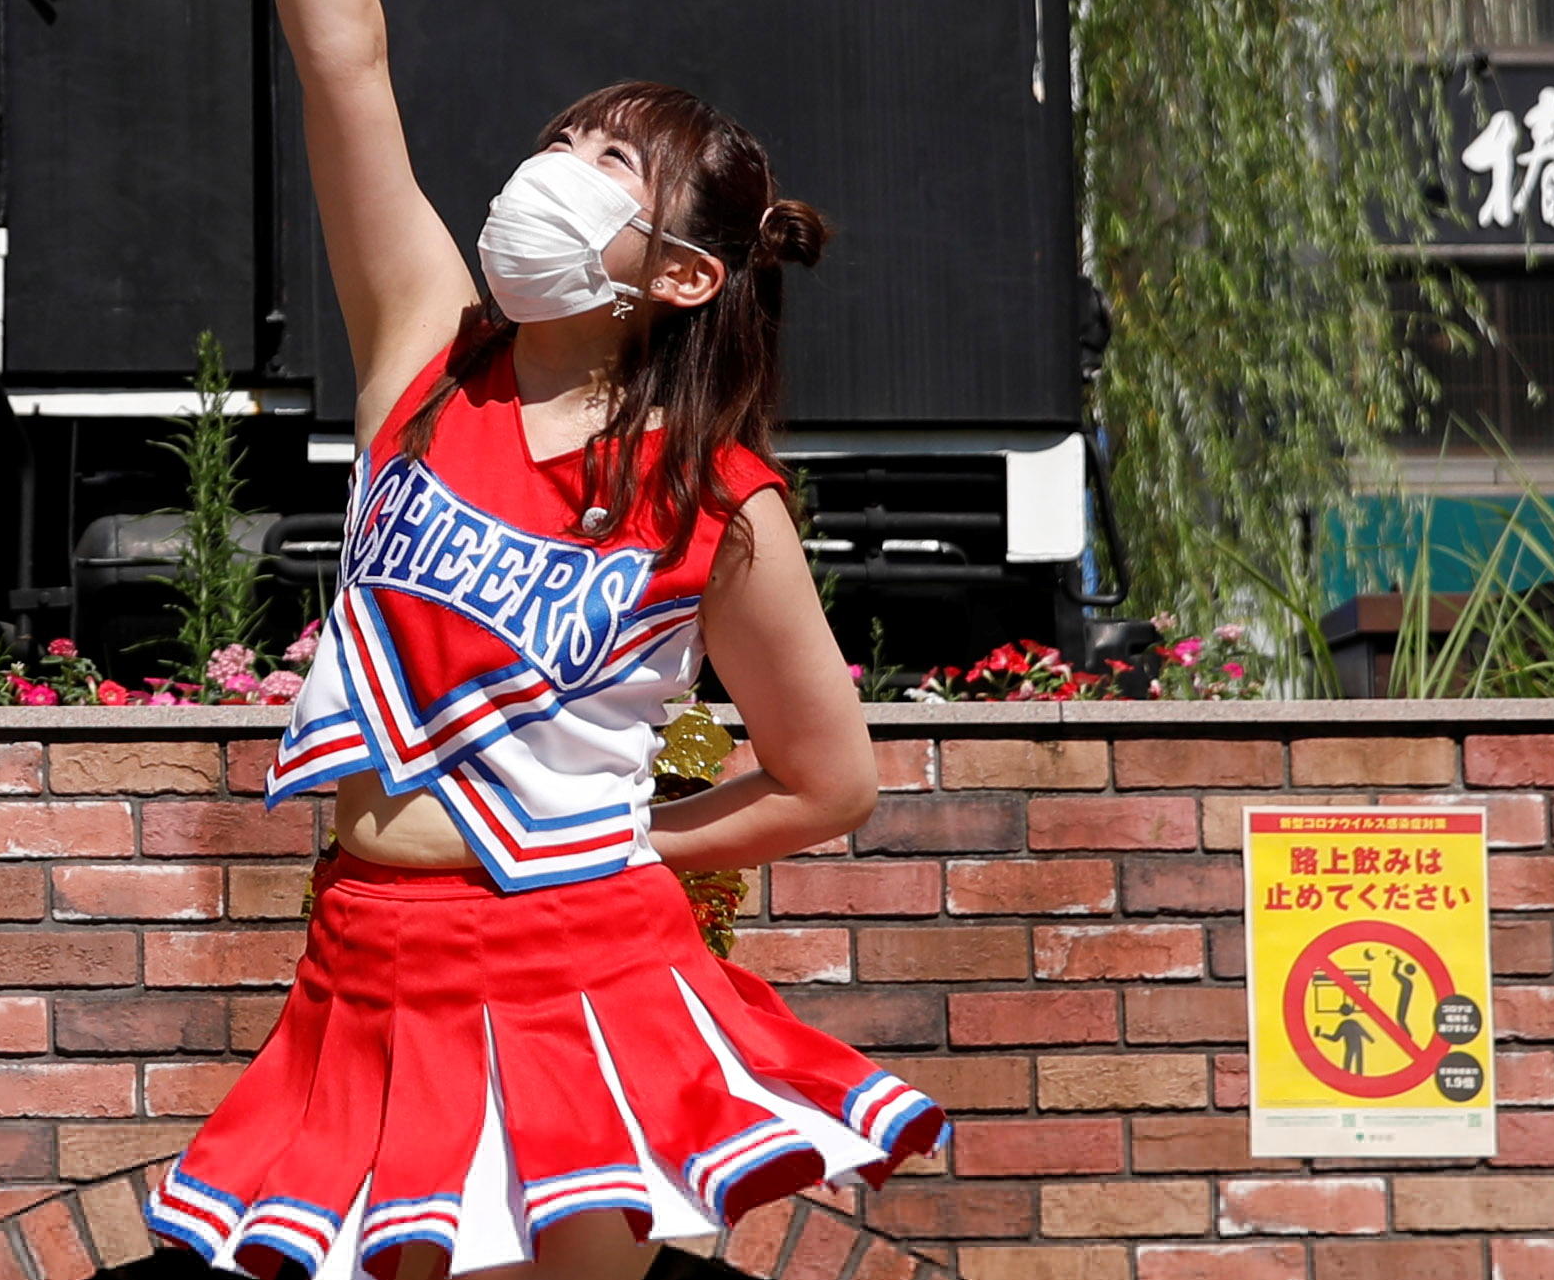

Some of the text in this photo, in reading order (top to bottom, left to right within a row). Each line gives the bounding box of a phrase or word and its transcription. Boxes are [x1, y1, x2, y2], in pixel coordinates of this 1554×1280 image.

[341, 452, 660, 693] CHEERS
[1290, 847, 1443, 875] 路上飲みは
[1264, 882, 1471, 912] 止めてください
